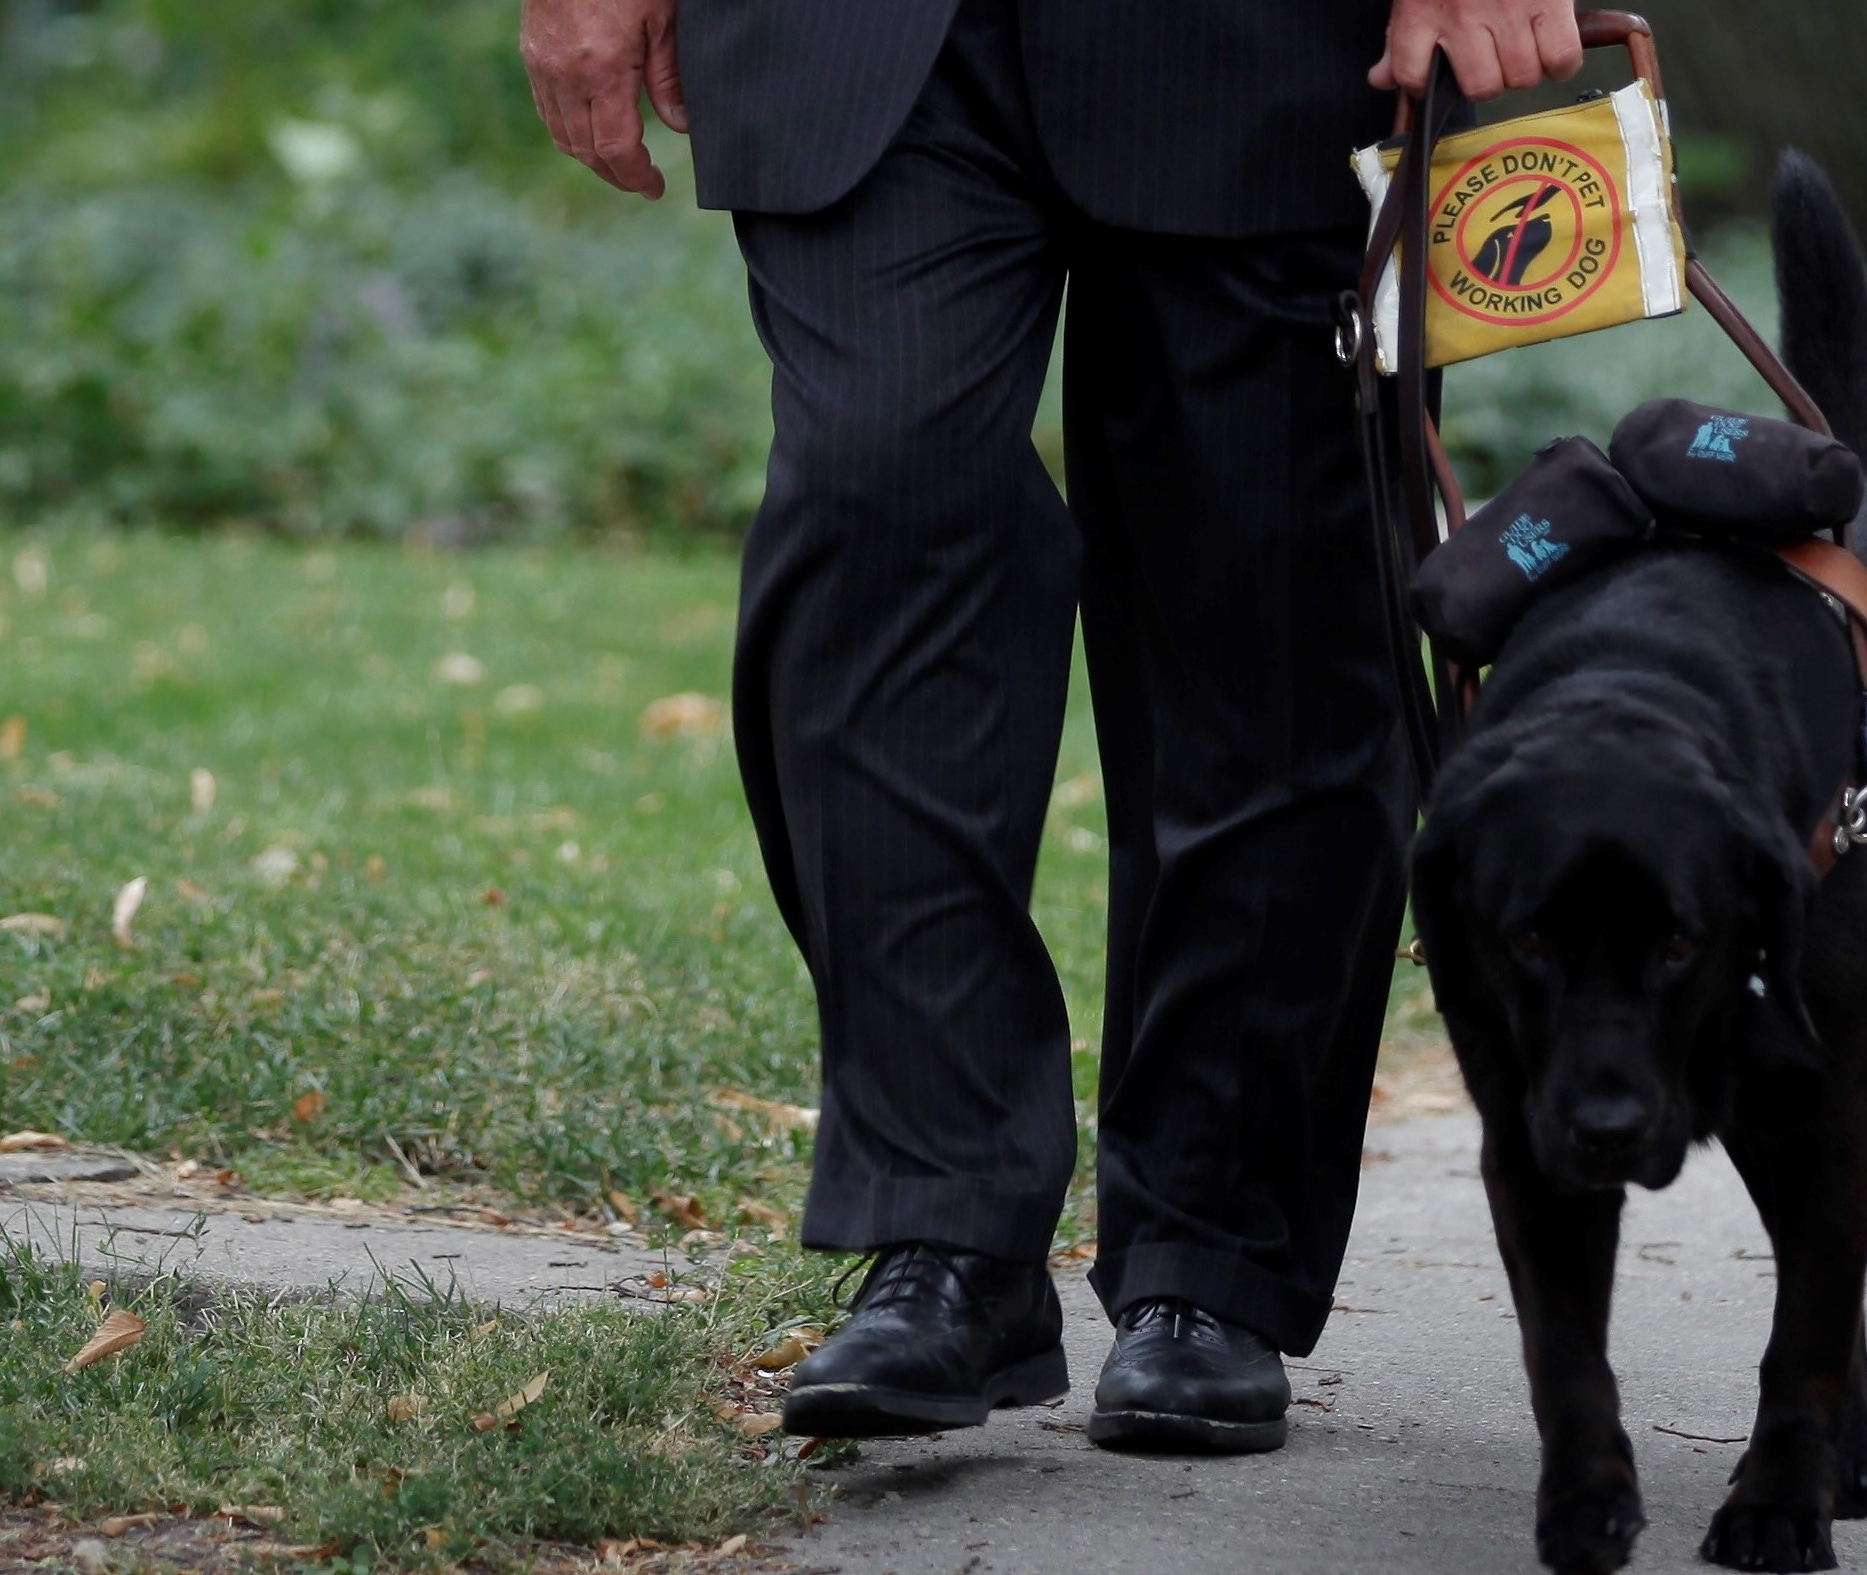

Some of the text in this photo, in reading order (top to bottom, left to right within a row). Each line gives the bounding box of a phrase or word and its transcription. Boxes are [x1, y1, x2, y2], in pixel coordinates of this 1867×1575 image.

[1432, 151, 1605, 244] PLEASE DON'T PET
[1448, 237, 1606, 313] WORKING DOG
